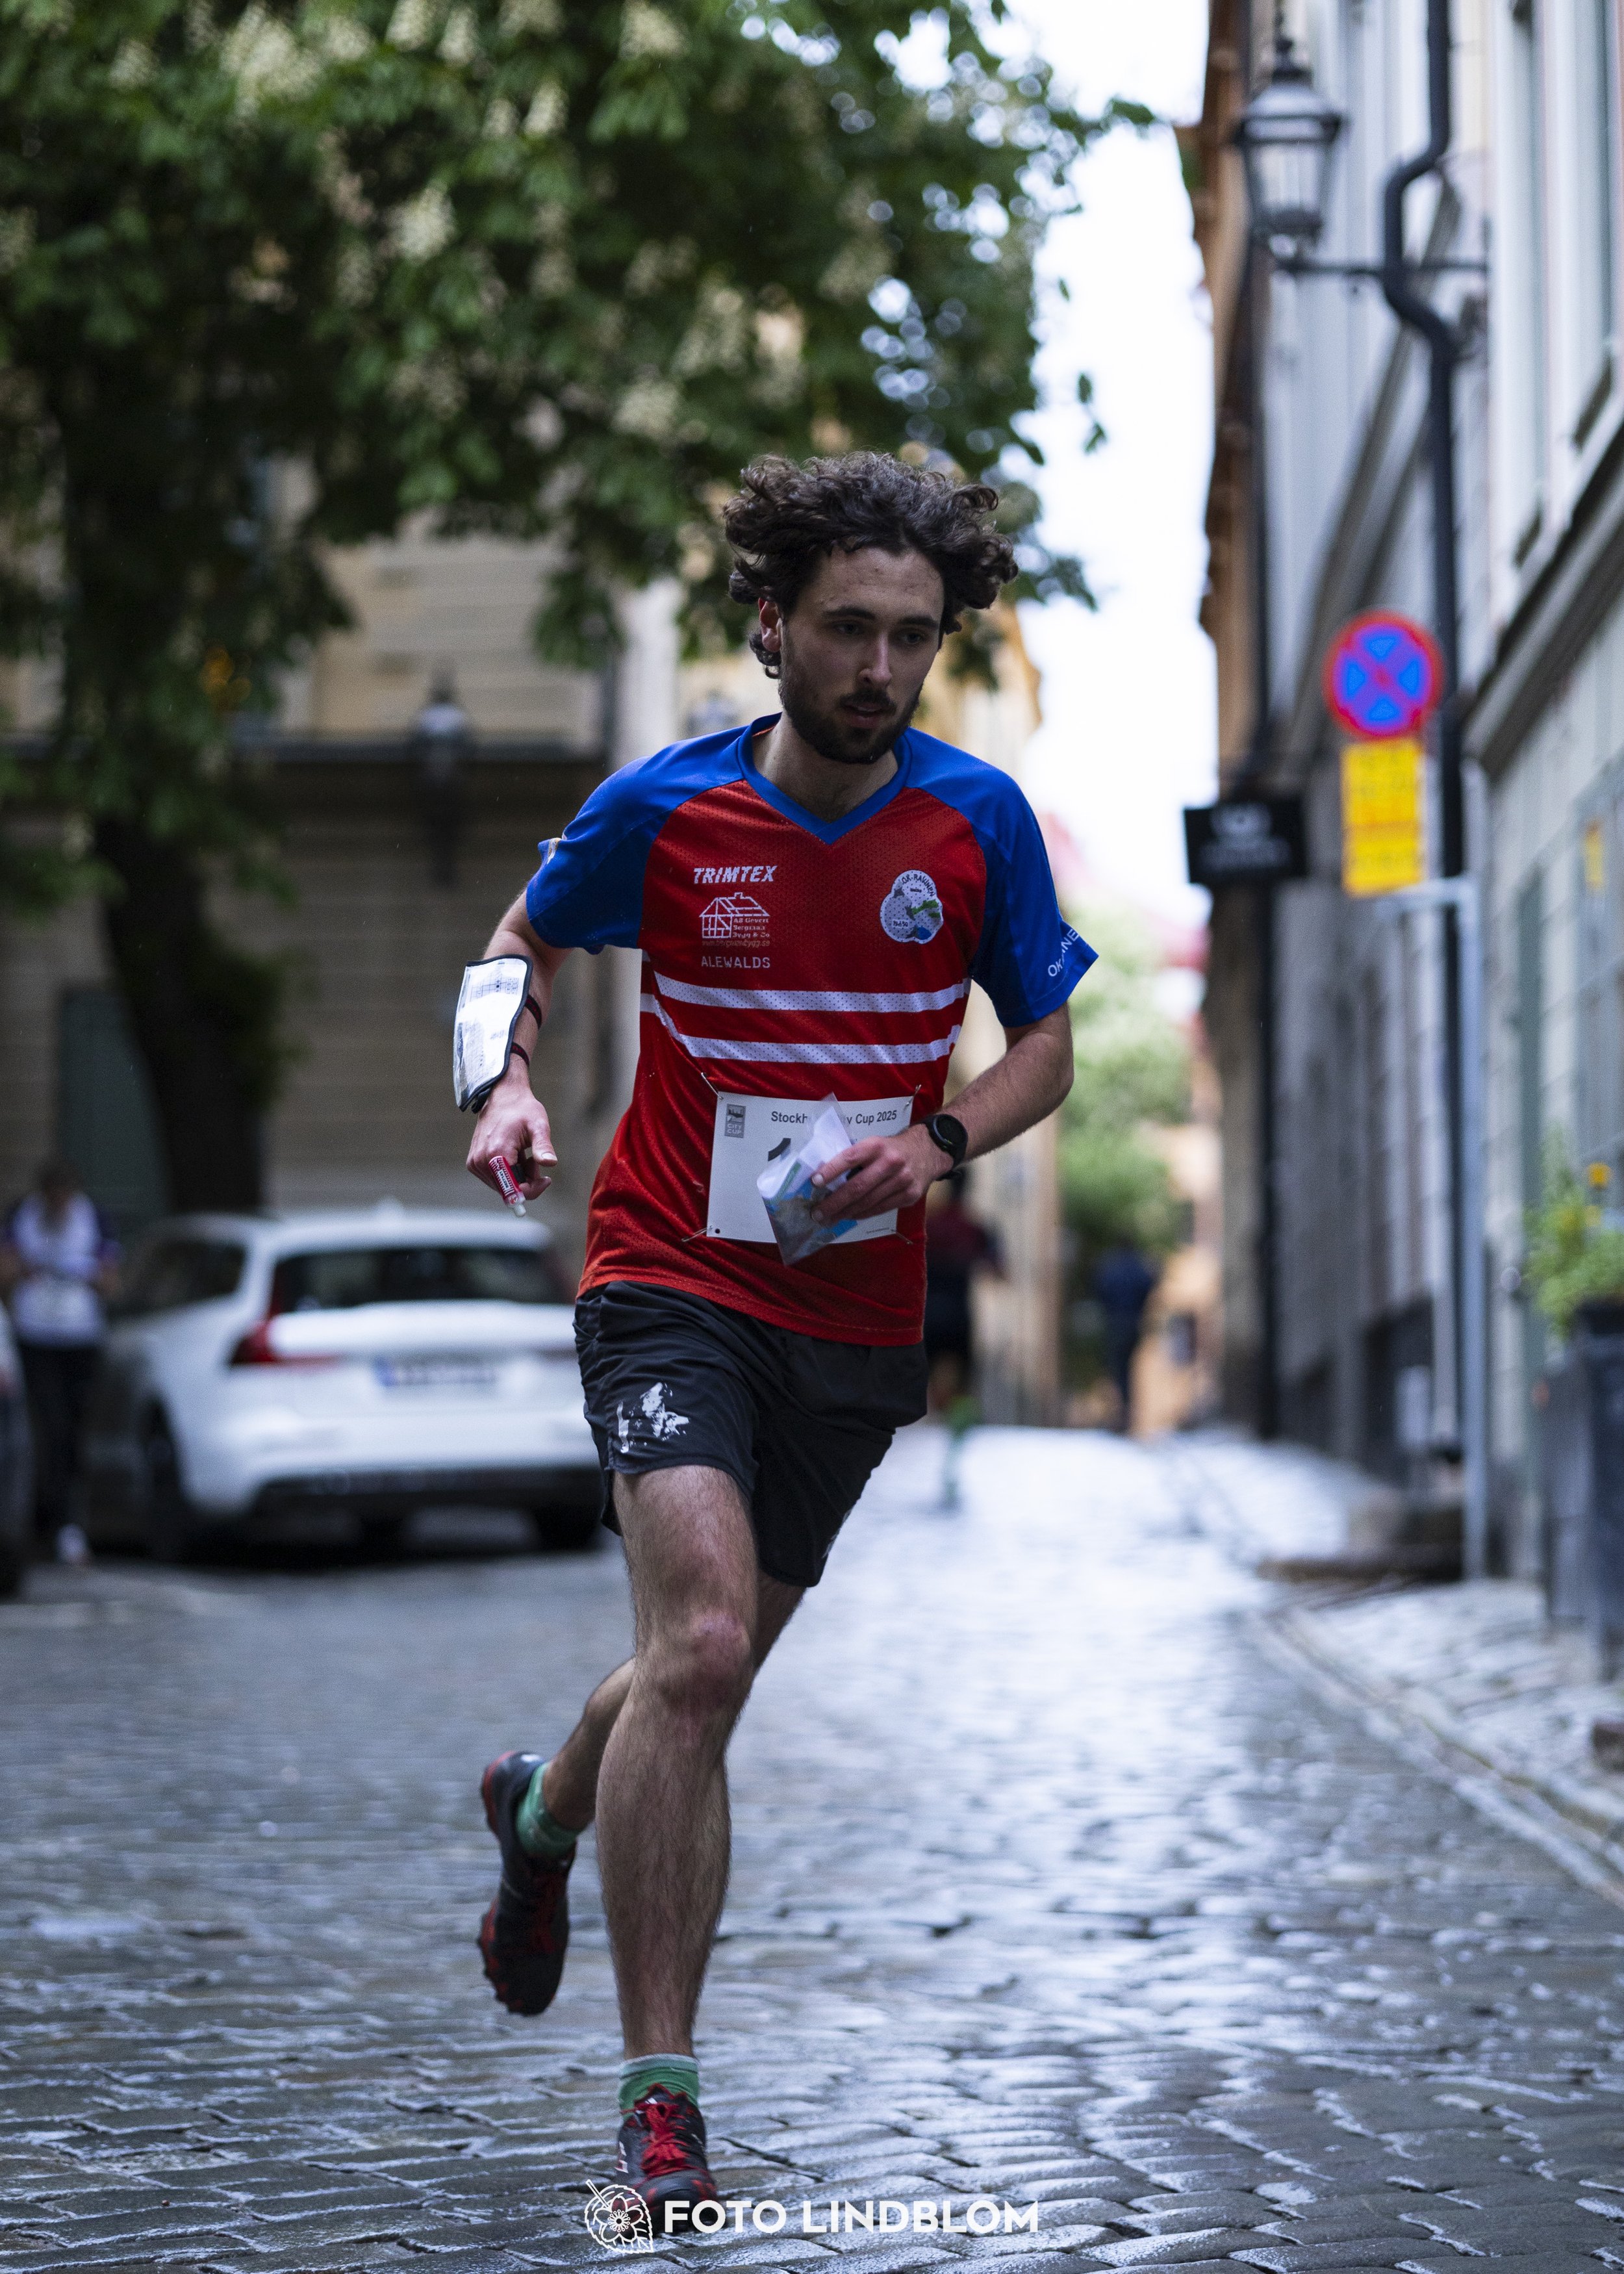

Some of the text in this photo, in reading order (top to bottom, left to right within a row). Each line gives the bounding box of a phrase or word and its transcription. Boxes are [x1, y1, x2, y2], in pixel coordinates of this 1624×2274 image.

[693, 865, 778, 884] TRIMTEX
[702, 956, 770, 968] ALEWALDS
[856, 1113, 874, 1125] Cup
[876, 1110, 897, 1122] 2025
